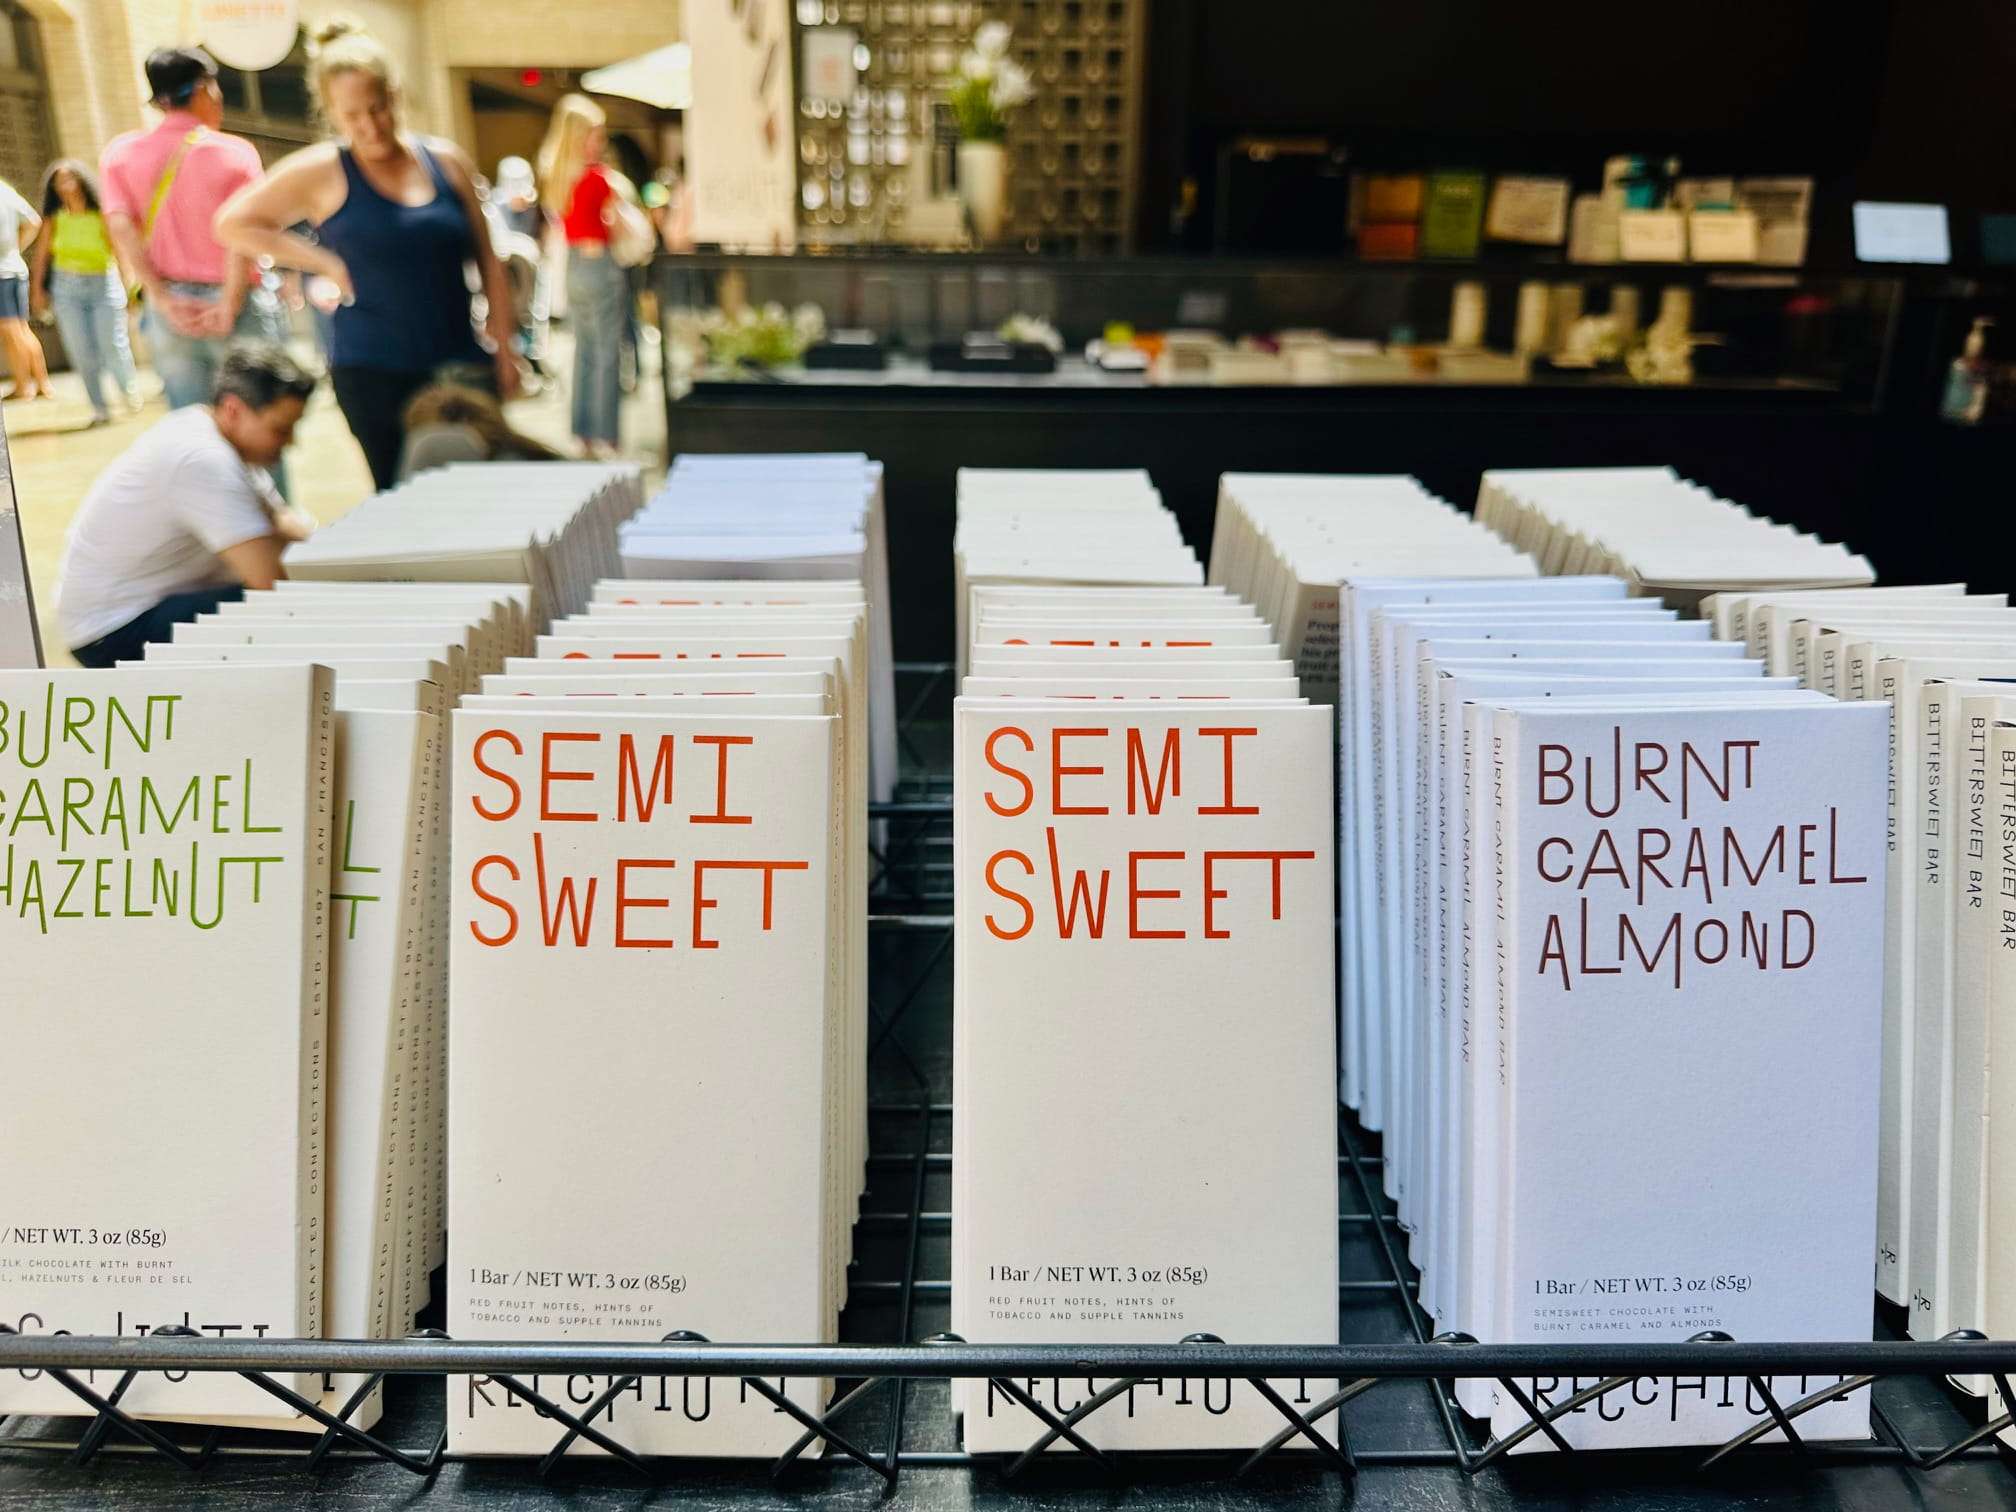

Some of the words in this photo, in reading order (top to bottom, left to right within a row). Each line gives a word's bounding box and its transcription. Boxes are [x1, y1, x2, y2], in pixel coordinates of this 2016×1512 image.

[0, 682, 182, 769] URNT
[471, 729, 754, 824] SEMI
[984, 726, 1260, 818] SEMI
[1537, 725, 1760, 820] BURNT
[1926, 703, 1940, 838] BITTERSWEET
[1967, 717, 1986, 860] BITTERSWEET
[0, 758, 283, 852] ARAMEL
[1999, 750, 2016, 900] BITTERSWEET
[1536, 807, 1868, 906] CARAMEL
[1925, 848, 1939, 884] BAR
[469, 832, 809, 949] SWEET
[984, 826, 1315, 940] SWEET
[1966, 870, 1983, 908] BAR
[1537, 897, 1816, 992] ALMOND
[2000, 909, 2016, 950] BAR
[14, 1228, 48, 1244] NET
[52, 1228, 83, 1244] WT.
[88, 1229, 98, 1244] 3
[102, 1232, 122, 1244] oz
[126, 1228, 167, 1248] (85g)
[21, 1273, 85, 1284] HAZELNUTS
[92, 1275, 99, 1283] &
[106, 1275, 142, 1284] FLEUR
[150, 1275, 163, 1284] DE
[172, 1275, 193, 1284] SEL
[29, 1258, 92, 1268] CHOCOLATE
[100, 1260, 129, 1269] WITH
[137, 1260, 173, 1269] BURNT
[481, 1269, 510, 1285] Bar
[526, 1271, 564, 1288] NET
[567, 1272, 600, 1288] WT.
[605, 1273, 615, 1289] 3
[620, 1276, 640, 1290] oz
[644, 1274, 687, 1293] (85g)
[1001, 1266, 1030, 1282] Bar
[1047, 1267, 1085, 1282] NET
[1089, 1267, 1122, 1282] WT.
[1127, 1267, 1137, 1282] 3
[1142, 1270, 1162, 1282] oz
[1165, 1266, 1208, 1285] (85g)
[989, 1296, 1011, 1305] RED
[1019, 1297, 1056, 1305] FRUIT
[1064, 1297, 1107, 1306] NOTES,
[1116, 1297, 1154, 1305] HINTS
[1162, 1297, 1176, 1305] OF
[1546, 1279, 1576, 1294] Bar
[1593, 1278, 1631, 1294] NET
[1635, 1277, 1667, 1293] WT.
[1672, 1277, 1683, 1292] 3
[1687, 1279, 1706, 1291] oz
[1711, 1274, 1752, 1292] (85g)
[470, 1298, 491, 1307] RED
[499, 1300, 536, 1309] FRUIT
[543, 1302, 585, 1312] NOTES,
[595, 1303, 631, 1312] HINTS
[640, 1304, 655, 1312] OF
[470, 1312, 521, 1323] TOBACCO
[528, 1315, 550, 1324] AND
[559, 1316, 602, 1326] SUPPLE
[612, 1318, 663, 1327] TANNINS
[990, 1311, 1041, 1320] TOBACCO
[1049, 1311, 1072, 1320] AND
[1080, 1312, 1124, 1320] SUPPLE
[1133, 1312, 1185, 1320] TANNINS
[1534, 1308, 1601, 1317] SEMISWEET
[1609, 1306, 1675, 1316] CHOCOLATE
[1684, 1305, 1713, 1314] WITH
[1534, 1322, 1571, 1331] BURNT
[1580, 1321, 1631, 1330] CARAMEL
[1640, 1320, 1662, 1329] AND
[1670, 1318, 1722, 1328] ALMONDS
